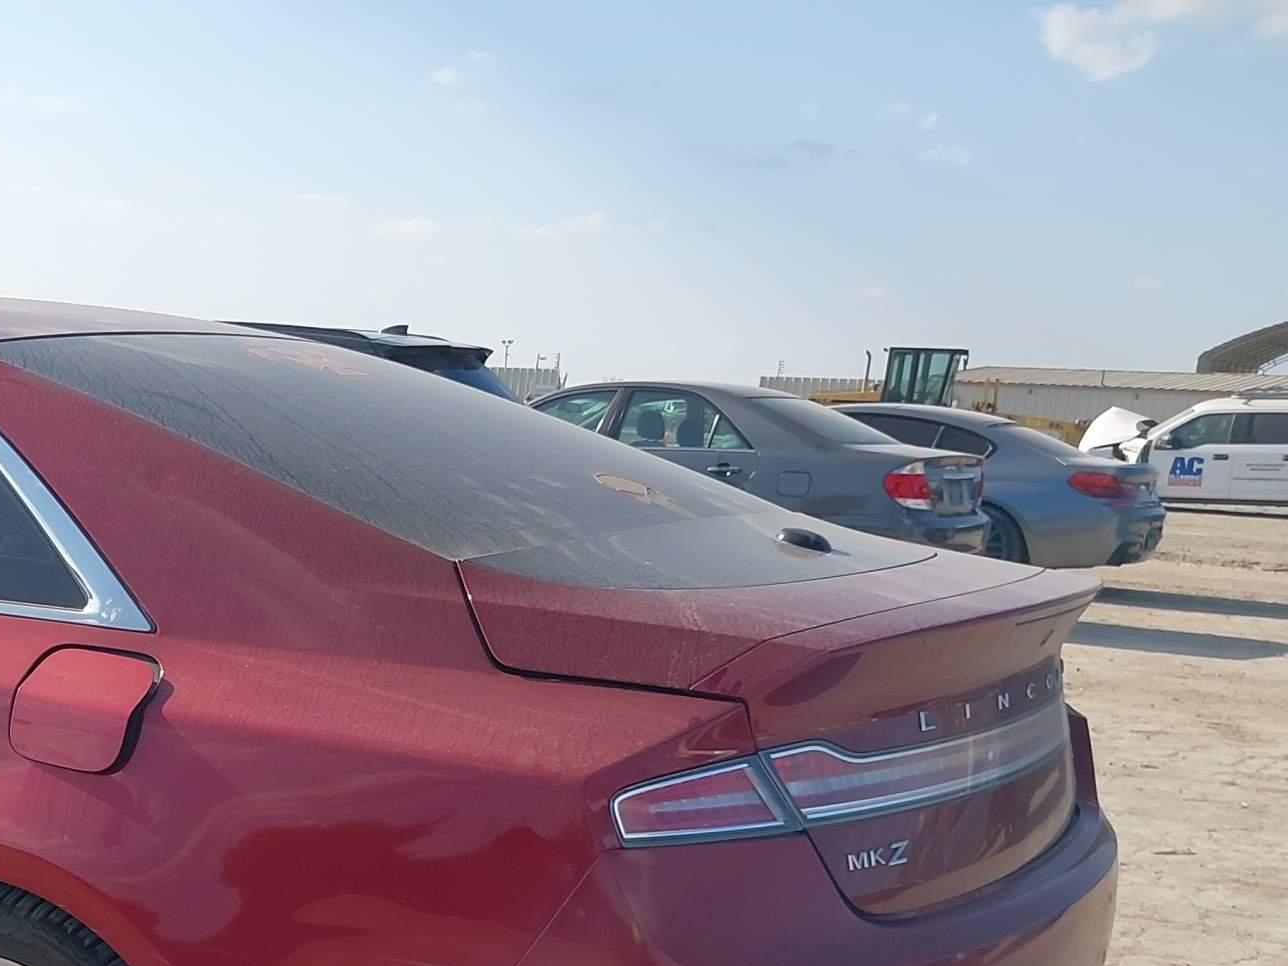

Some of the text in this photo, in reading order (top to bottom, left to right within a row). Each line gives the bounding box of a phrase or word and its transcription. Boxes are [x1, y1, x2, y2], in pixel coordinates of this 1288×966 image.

[1168, 456, 1205, 476] AC
[918, 660, 1063, 732] LINCO
[847, 839, 909, 871] MKZ
